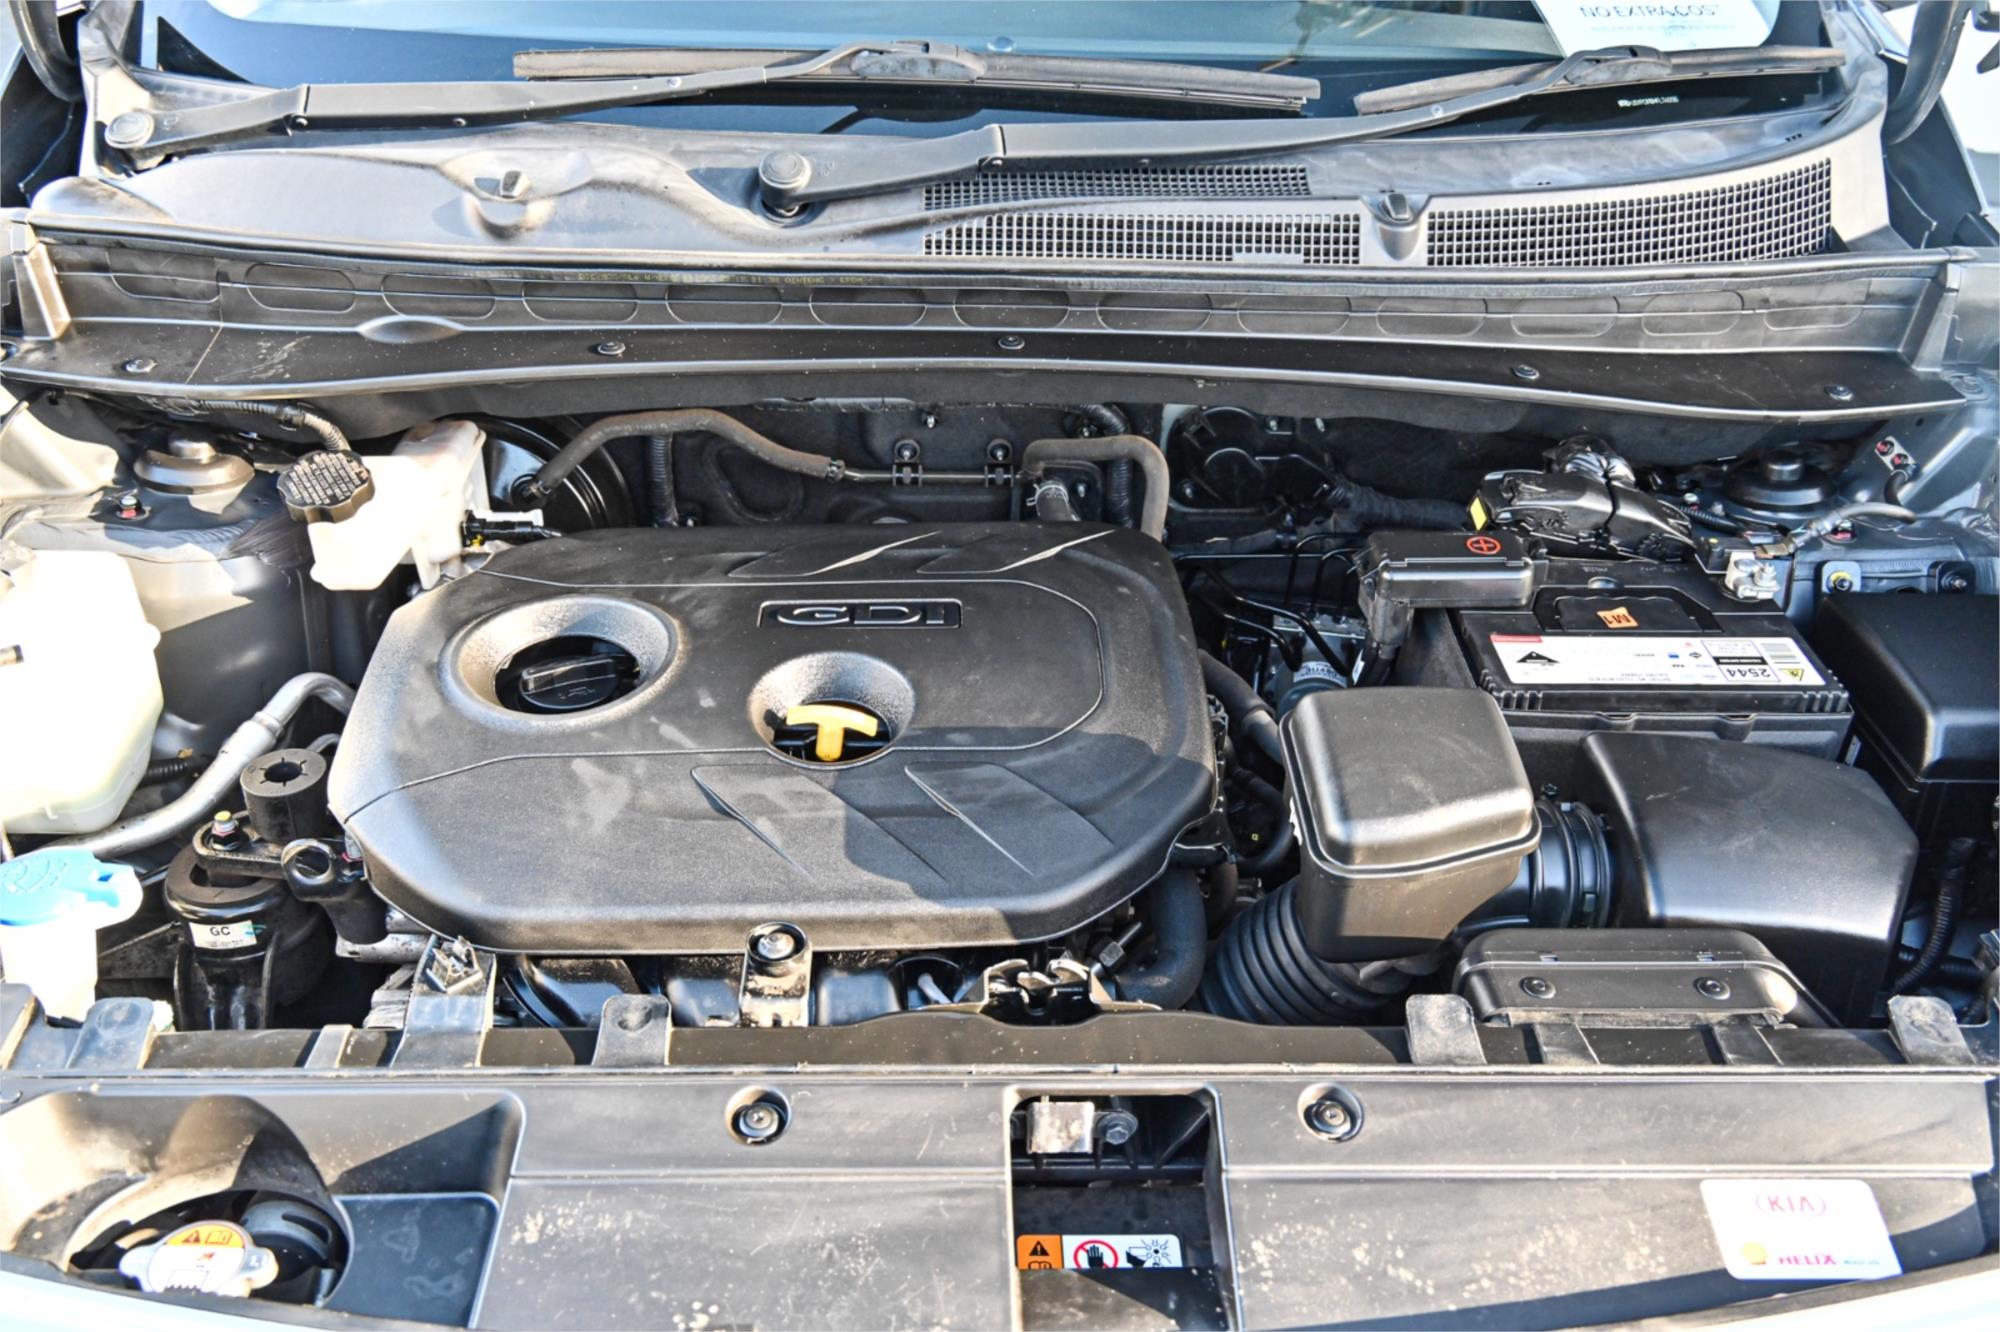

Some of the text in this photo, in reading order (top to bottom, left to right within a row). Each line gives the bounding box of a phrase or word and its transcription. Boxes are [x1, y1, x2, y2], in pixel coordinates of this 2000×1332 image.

[1579, 5, 1611, 17] NO
[777, 605, 945, 625] GDI
[1602, 614, 1632, 624] M1
[1726, 668, 1771, 678] 2544
[209, 926, 231, 936] GC
[1778, 1254, 1837, 1266] HELIX
